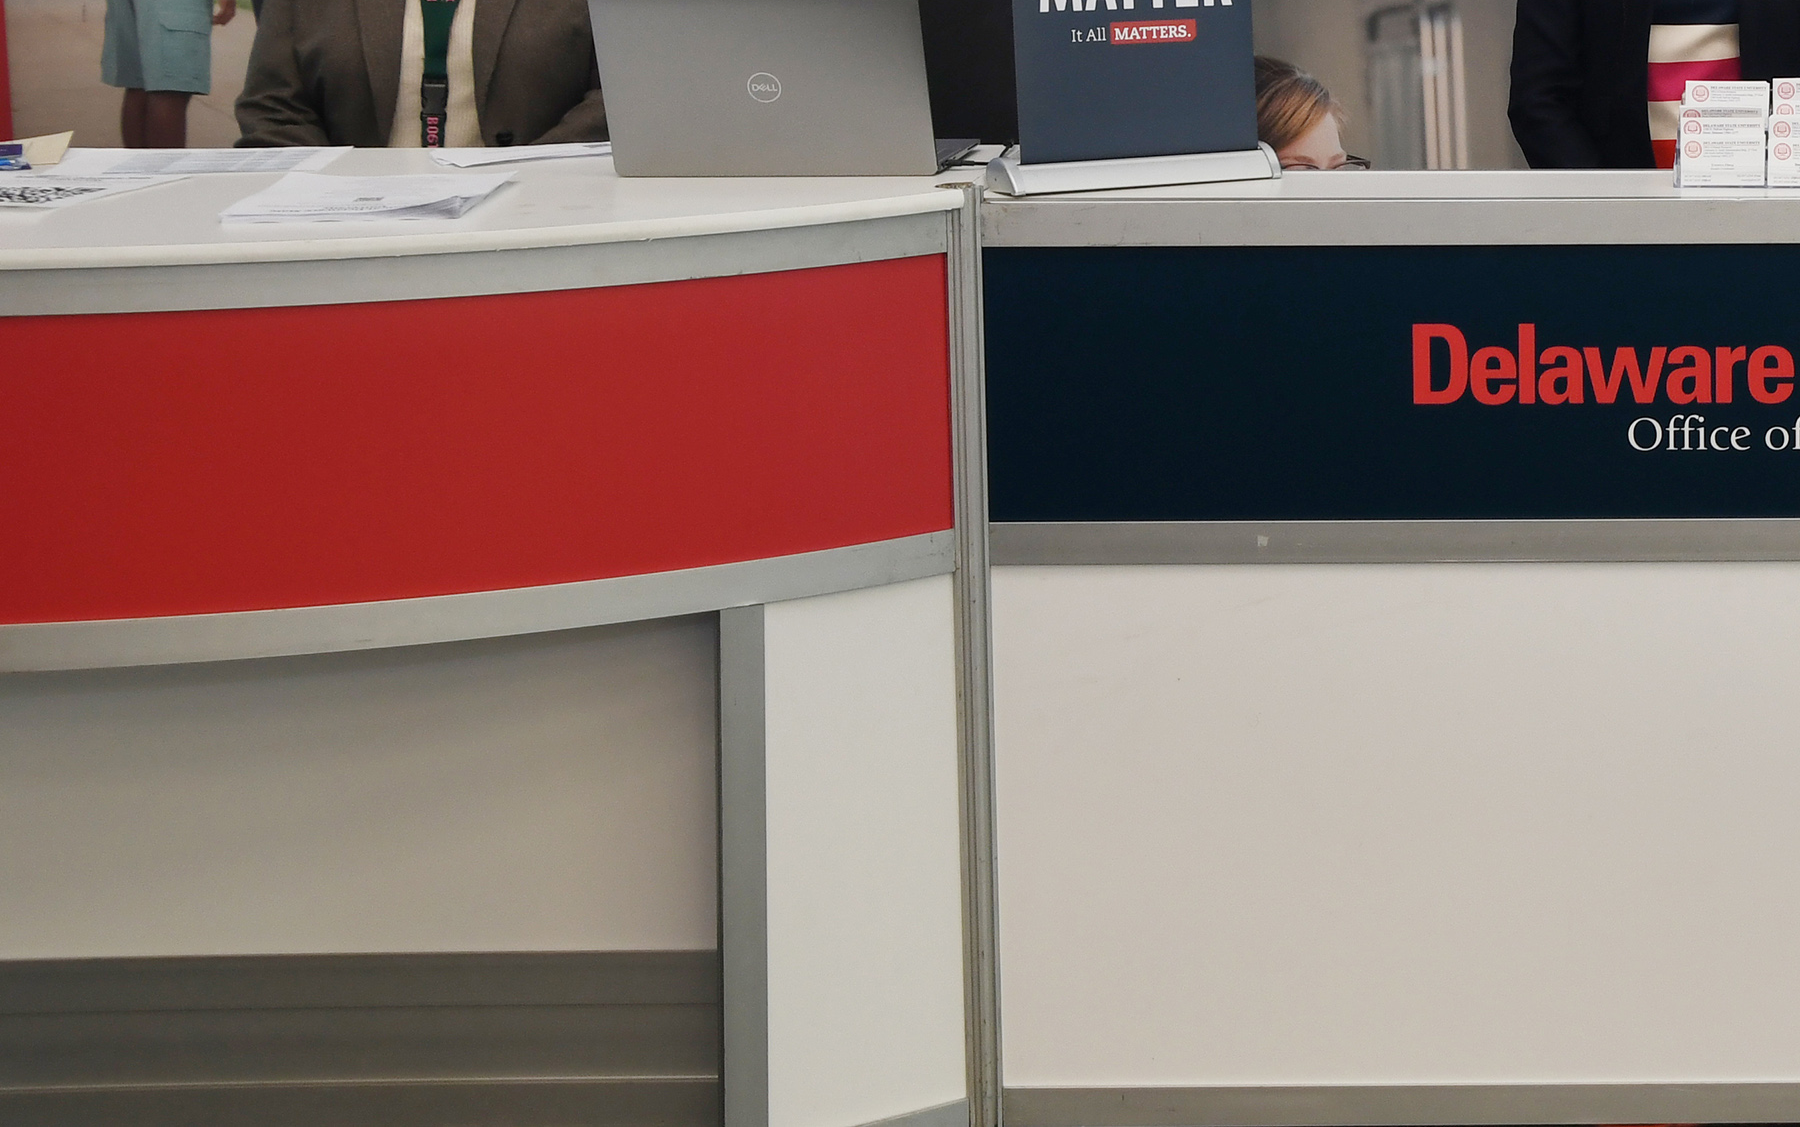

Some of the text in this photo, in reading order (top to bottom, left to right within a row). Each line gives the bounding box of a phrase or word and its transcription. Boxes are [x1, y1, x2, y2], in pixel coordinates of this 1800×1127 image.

[1071, 24, 1192, 43] It All MATTERS.
[751, 83, 778, 92] DELL
[1411, 322, 1795, 406] Delaware
[1627, 414, 1751, 451] Office
